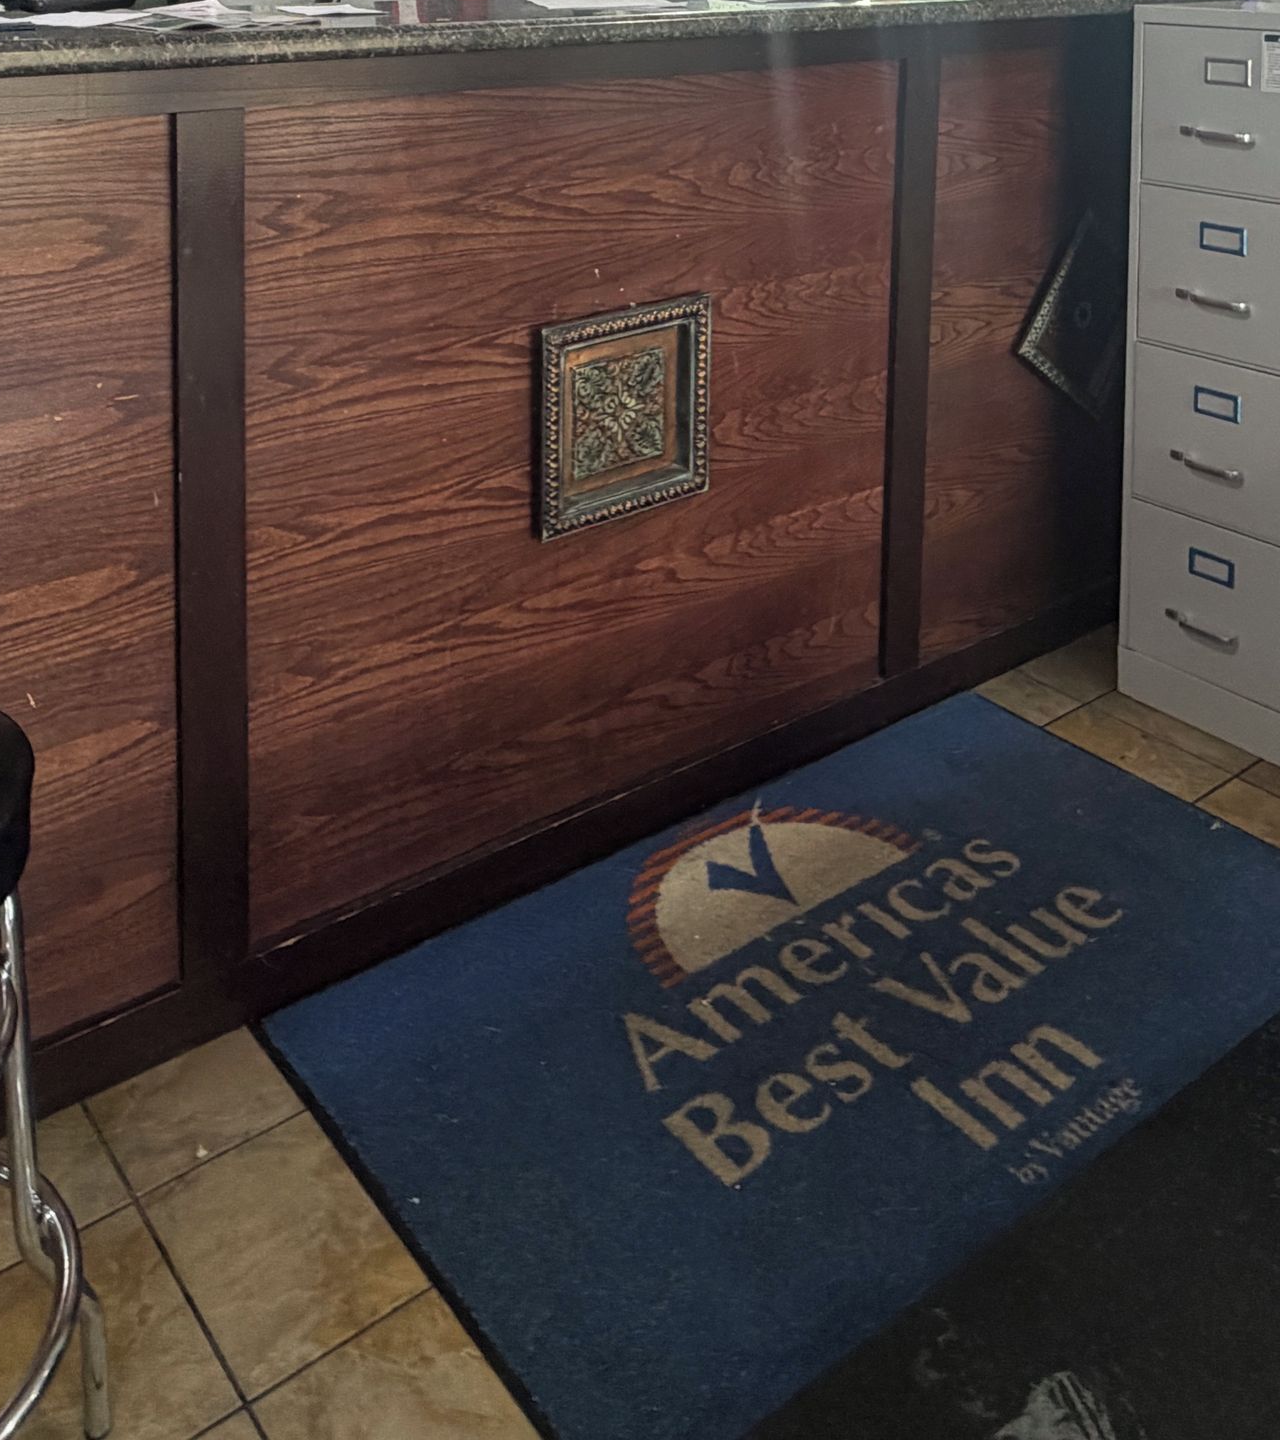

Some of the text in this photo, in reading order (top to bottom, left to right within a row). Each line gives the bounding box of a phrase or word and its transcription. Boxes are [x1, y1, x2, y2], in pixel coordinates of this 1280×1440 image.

[623, 838, 1020, 1092] Americas
[661, 886, 1122, 1187] Best Value
[911, 1023, 1105, 1150] Inn
[1008, 1078, 1143, 1185] by Vantage
